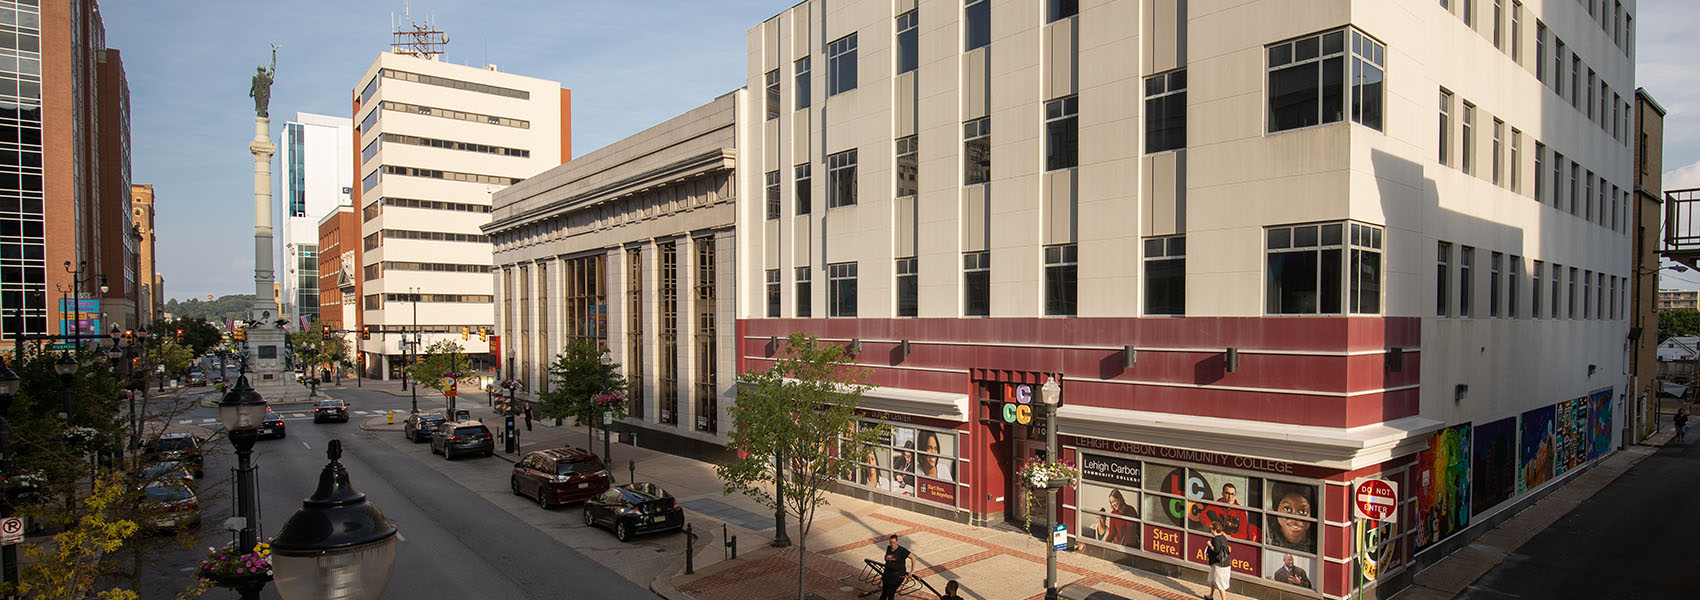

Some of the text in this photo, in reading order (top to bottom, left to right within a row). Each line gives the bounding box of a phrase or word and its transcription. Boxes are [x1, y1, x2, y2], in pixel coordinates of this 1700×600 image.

[1075, 437, 1293, 474] LEHIGH CARBON COMMUNITY COLLEGE
[1083, 458, 1141, 476] Lehigh Carbon
[1083, 469, 1114, 478] COMMUNITY
[1361, 485, 1391, 496] DO NOT
[1363, 503, 1388, 514] ENTER
[1153, 528, 1179, 544] Start
[1152, 540, 1179, 556] Here.
